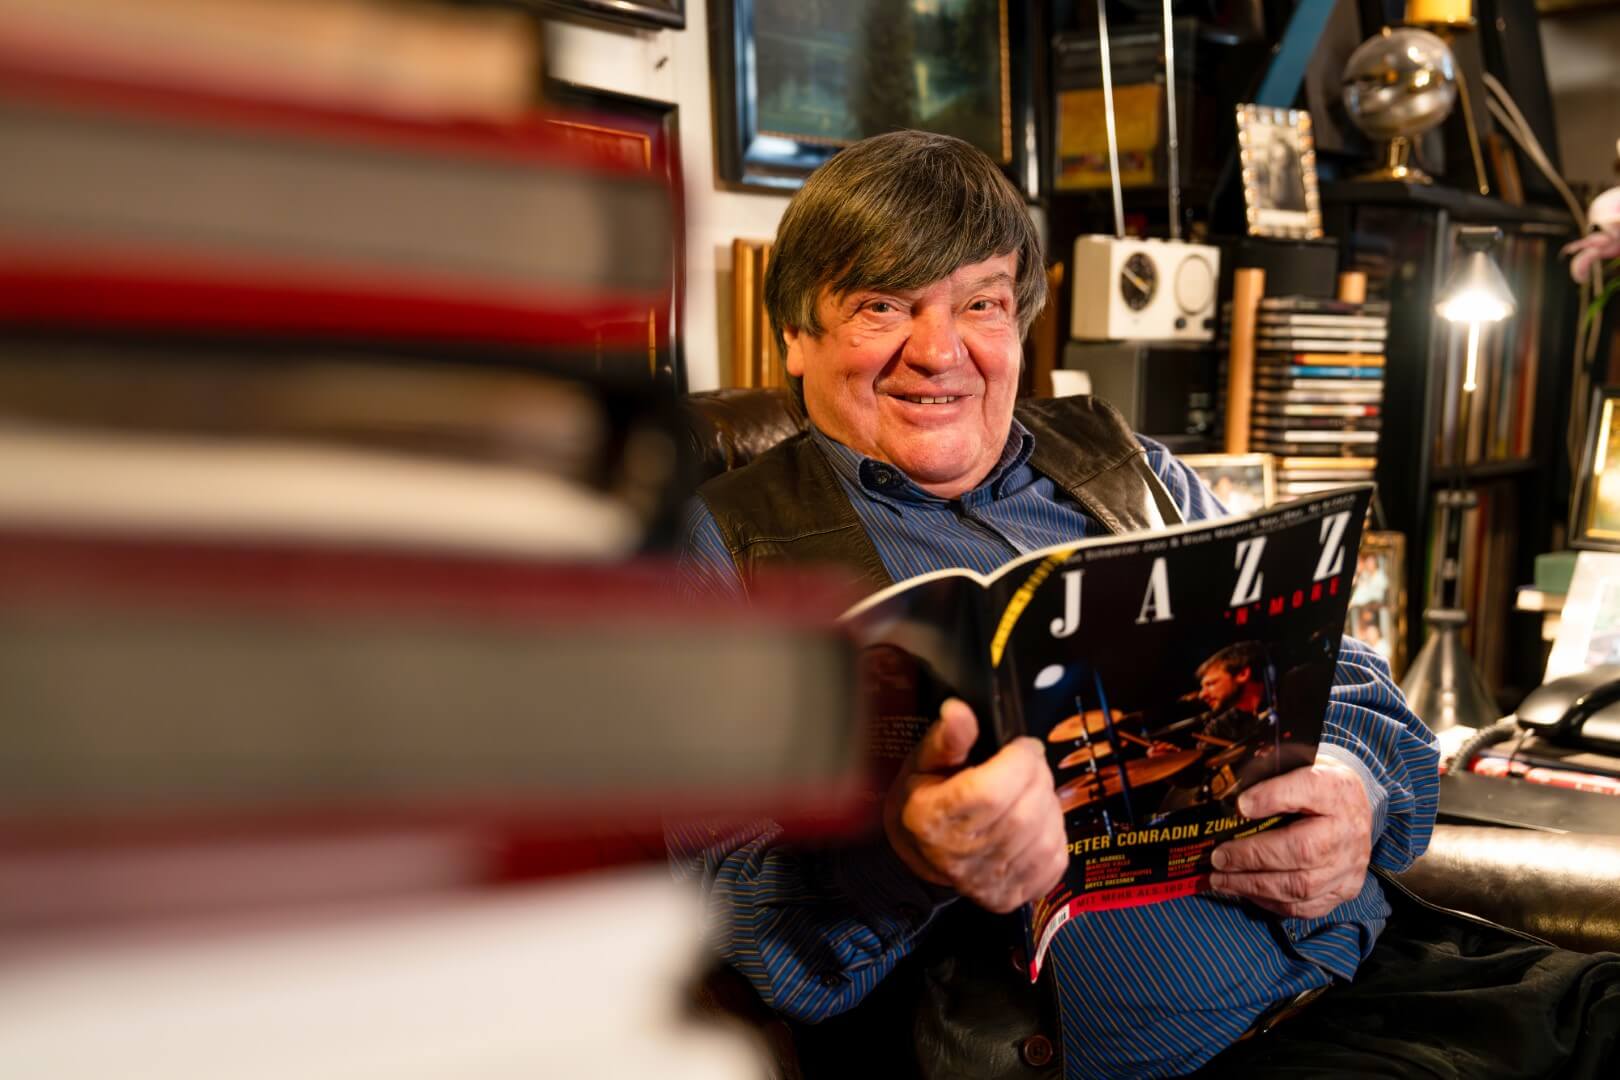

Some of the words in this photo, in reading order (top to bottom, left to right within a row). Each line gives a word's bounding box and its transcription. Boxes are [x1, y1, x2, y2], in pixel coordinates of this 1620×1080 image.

[1049, 510, 1351, 639] JAZZ
[1268, 575, 1340, 617] MORE
[1065, 834, 1111, 856] PETER
[1117, 824, 1199, 848] CONRADIN
